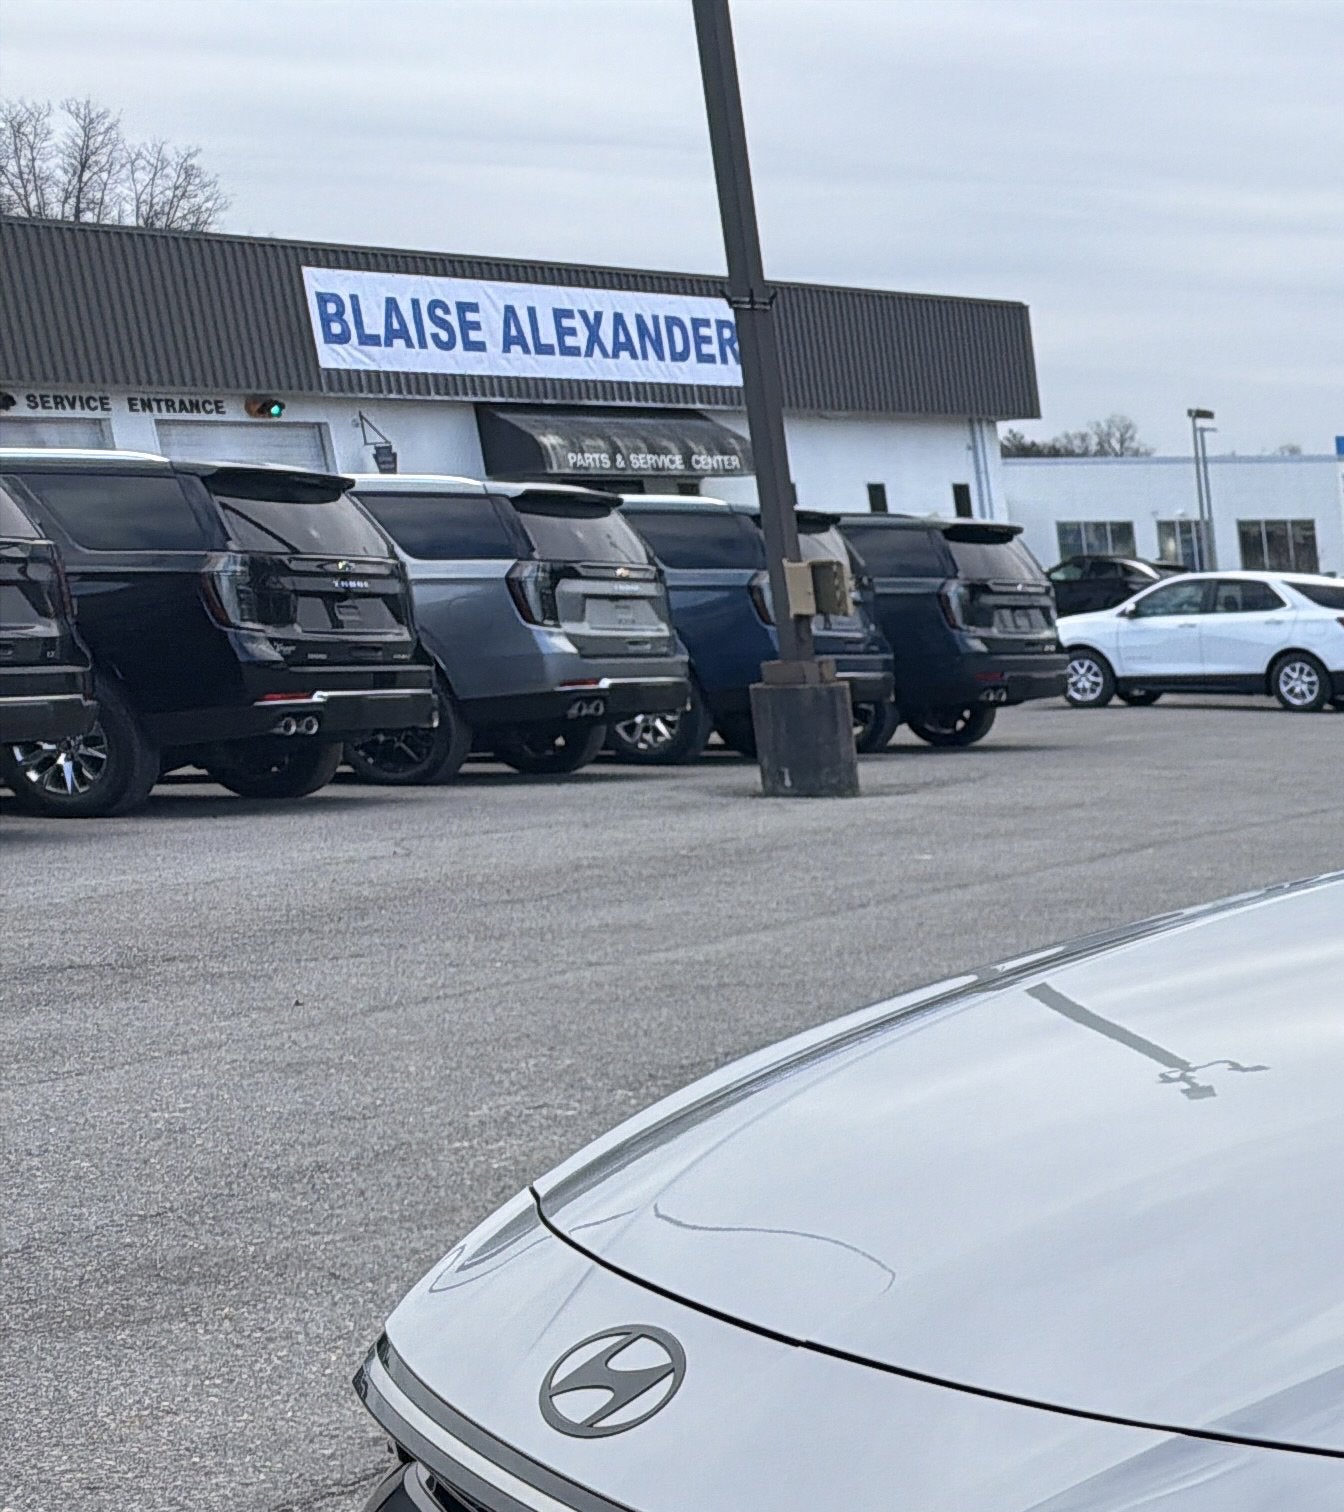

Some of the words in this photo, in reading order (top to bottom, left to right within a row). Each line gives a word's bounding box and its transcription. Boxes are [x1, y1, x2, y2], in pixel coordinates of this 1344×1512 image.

[315, 291, 487, 353] BLAISE
[502, 304, 740, 365] ALEXANDER
[26, 393, 112, 412] SERVICE
[127, 397, 226, 415] ENTRANCE
[567, 452, 611, 469] PARTS
[616, 453, 626, 469] &
[629, 453, 685, 469] SERVICE
[691, 455, 741, 470] CENTER
